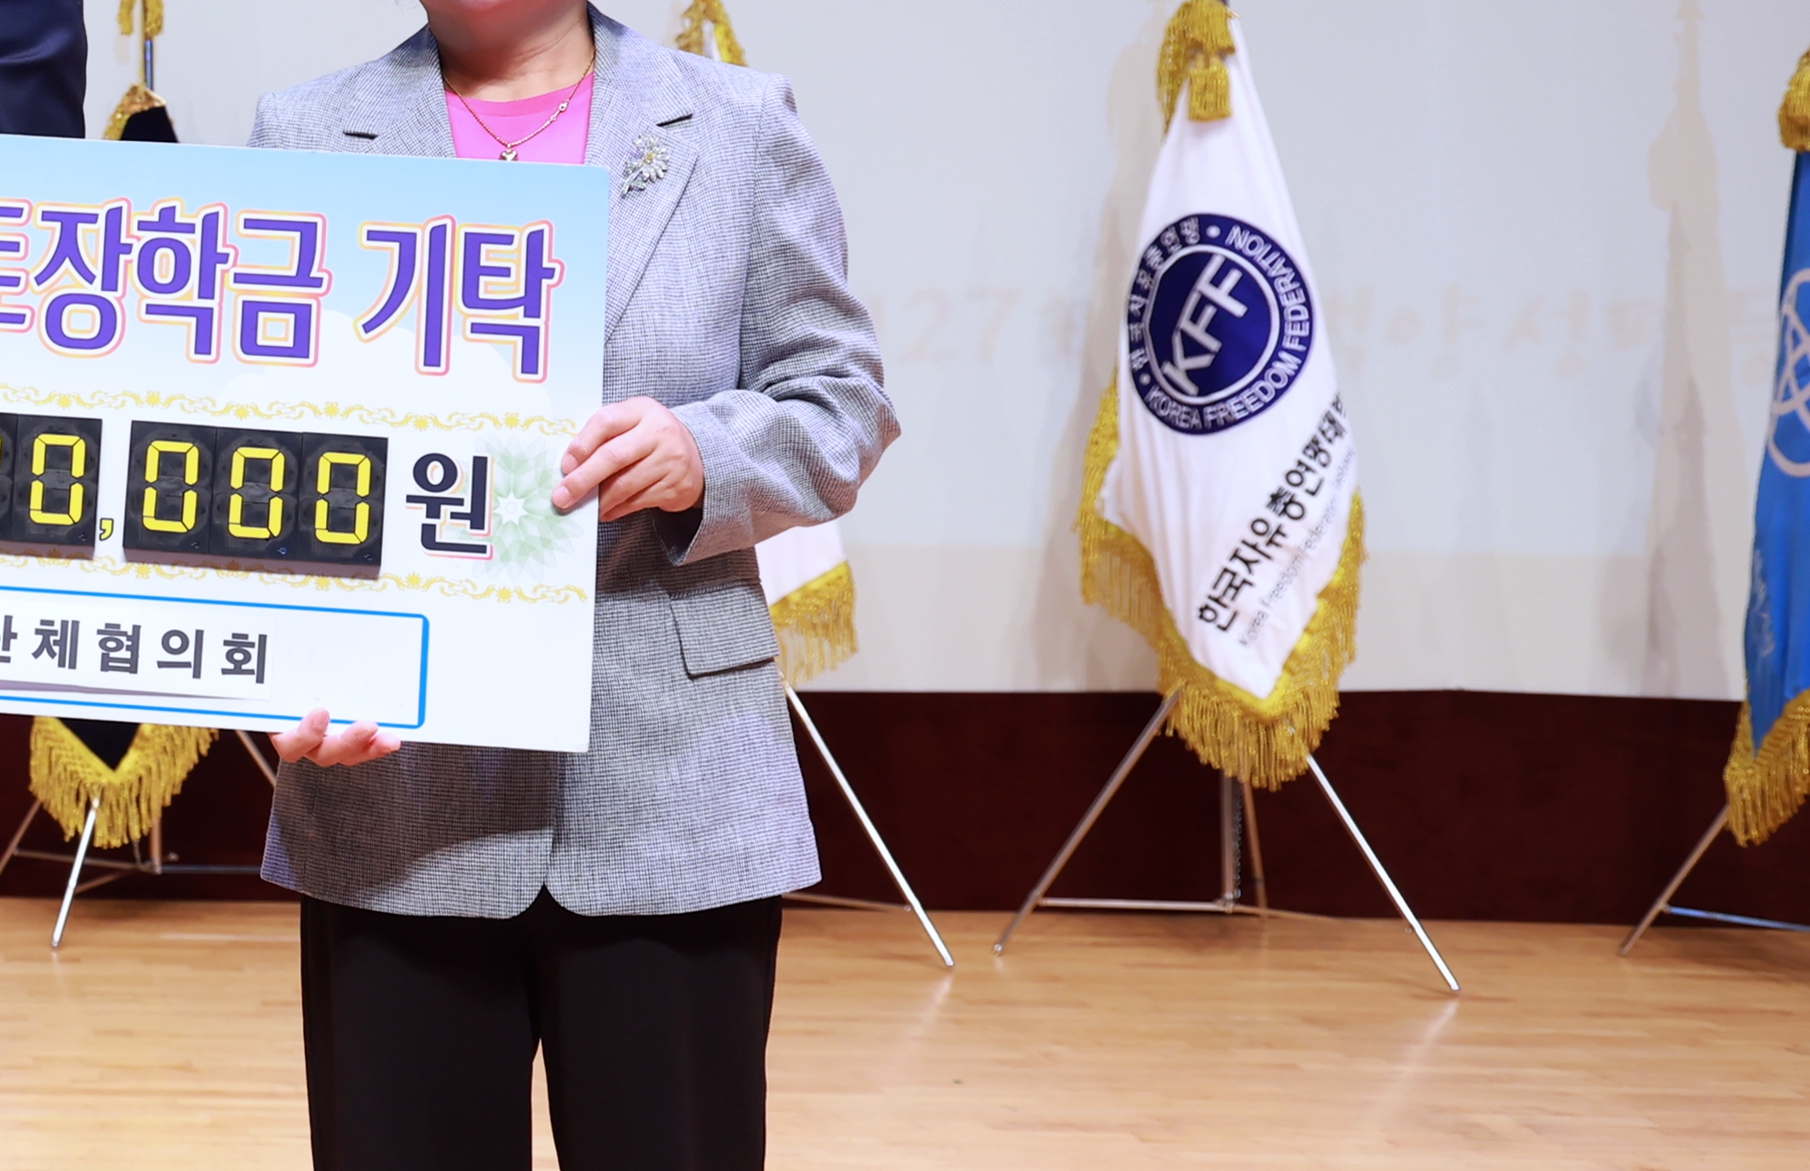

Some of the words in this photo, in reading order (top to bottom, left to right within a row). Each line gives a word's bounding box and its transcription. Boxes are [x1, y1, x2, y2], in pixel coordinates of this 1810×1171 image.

[358, 219, 560, 378] 기탁
[1160, 253, 1249, 397] KFF
[1224, 223, 1311, 352] FEDERATION
[1145, 385, 1203, 430] KOREA
[1204, 349, 1303, 429] FREEDOM
[404, 452, 492, 557] 원
